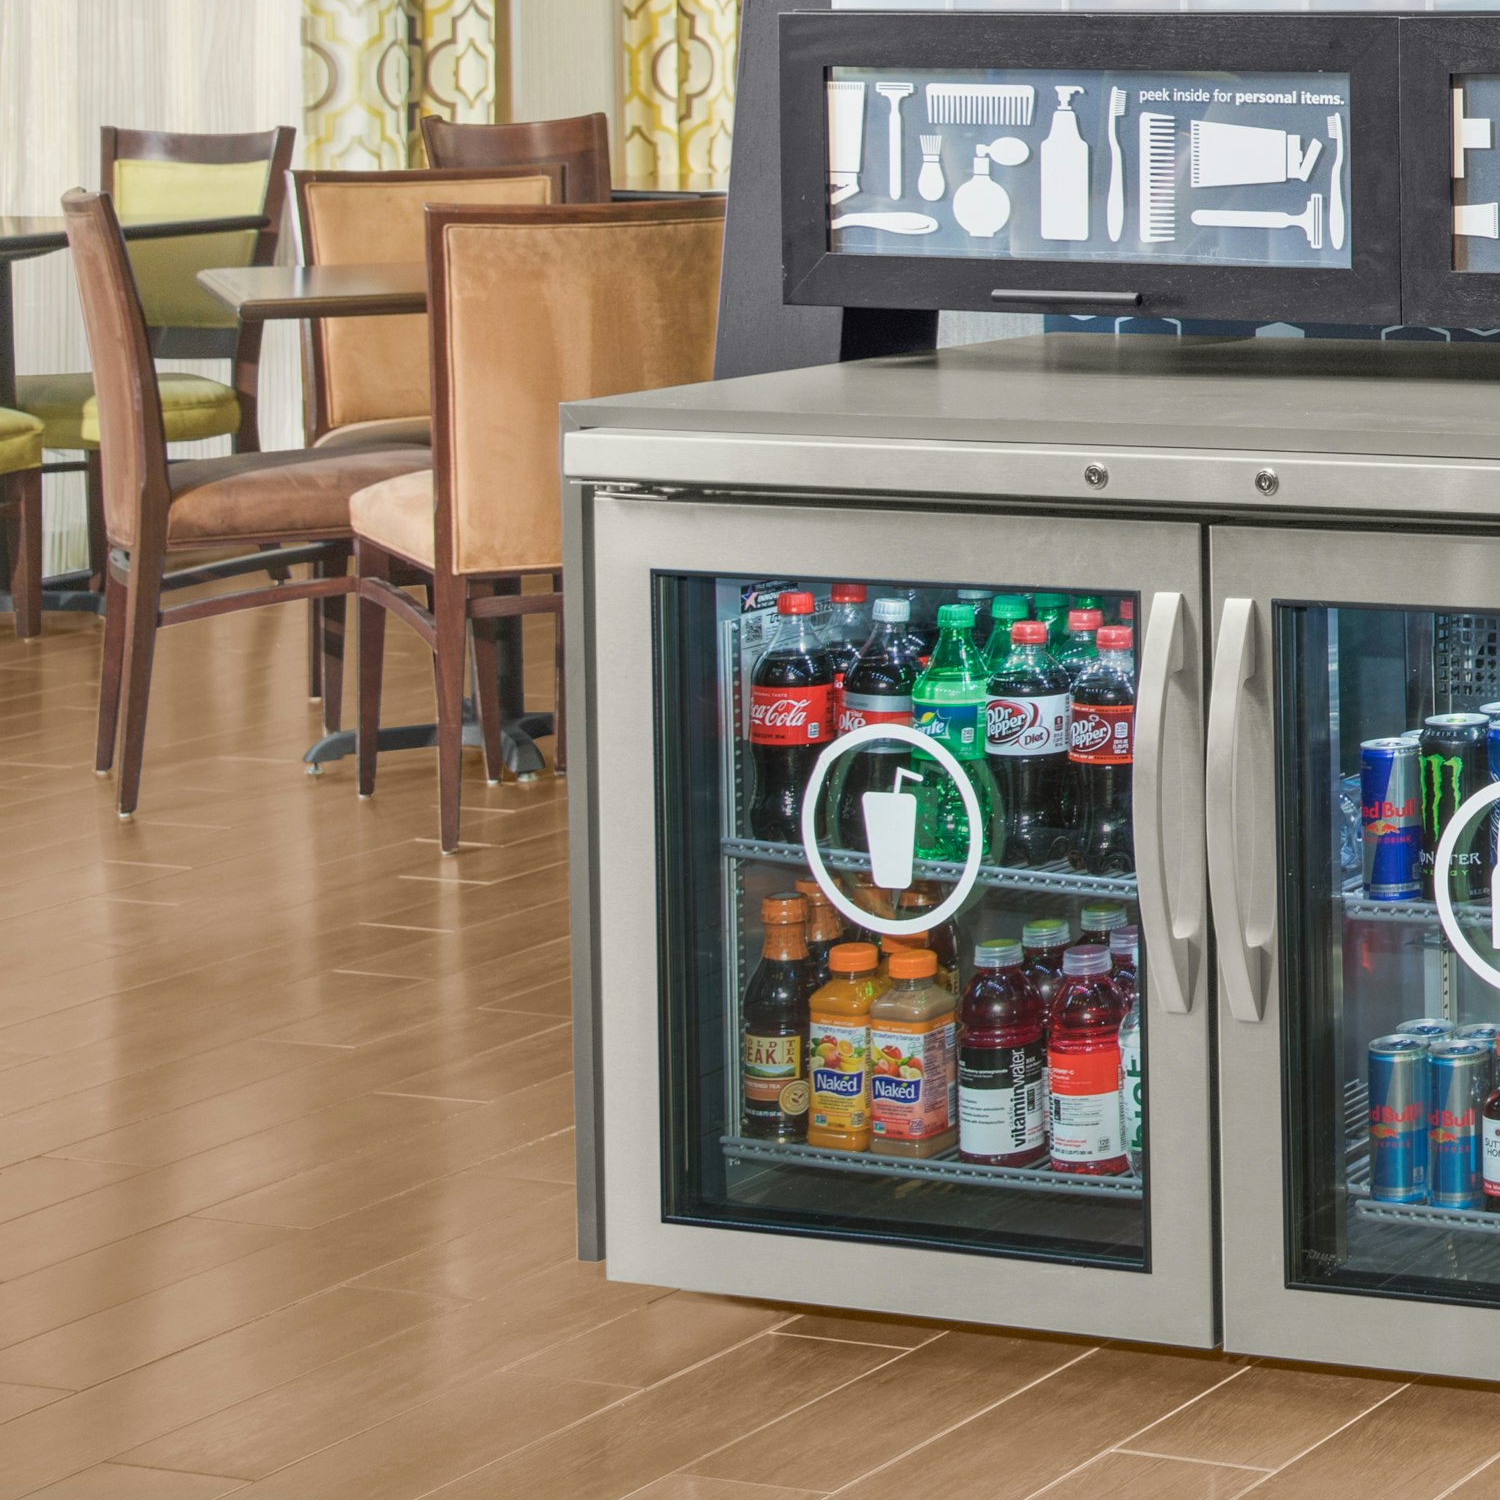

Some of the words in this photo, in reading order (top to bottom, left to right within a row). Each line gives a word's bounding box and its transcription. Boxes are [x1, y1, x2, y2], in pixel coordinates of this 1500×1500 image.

[1139, 87, 1170, 103] peek
[1173, 88, 1210, 102] inside
[1213, 88, 1233, 103] for
[1235, 90, 1297, 105] personal
[1300, 91, 1345, 106] items.
[986, 705, 1026, 739] Pepper
[993, 706, 1014, 720] Dr
[1071, 721, 1107, 748] Pepper
[1080, 721, 1096, 735] Dr
[1024, 731, 1045, 746] Diet
[1381, 799, 1415, 818] Bull
[1419, 850, 1482, 867] ONTER
[816, 1074, 859, 1093] Naked
[875, 1081, 917, 1100] Naked
[1382, 1103, 1416, 1124] Bull
[1441, 1108, 1475, 1128] Bull
